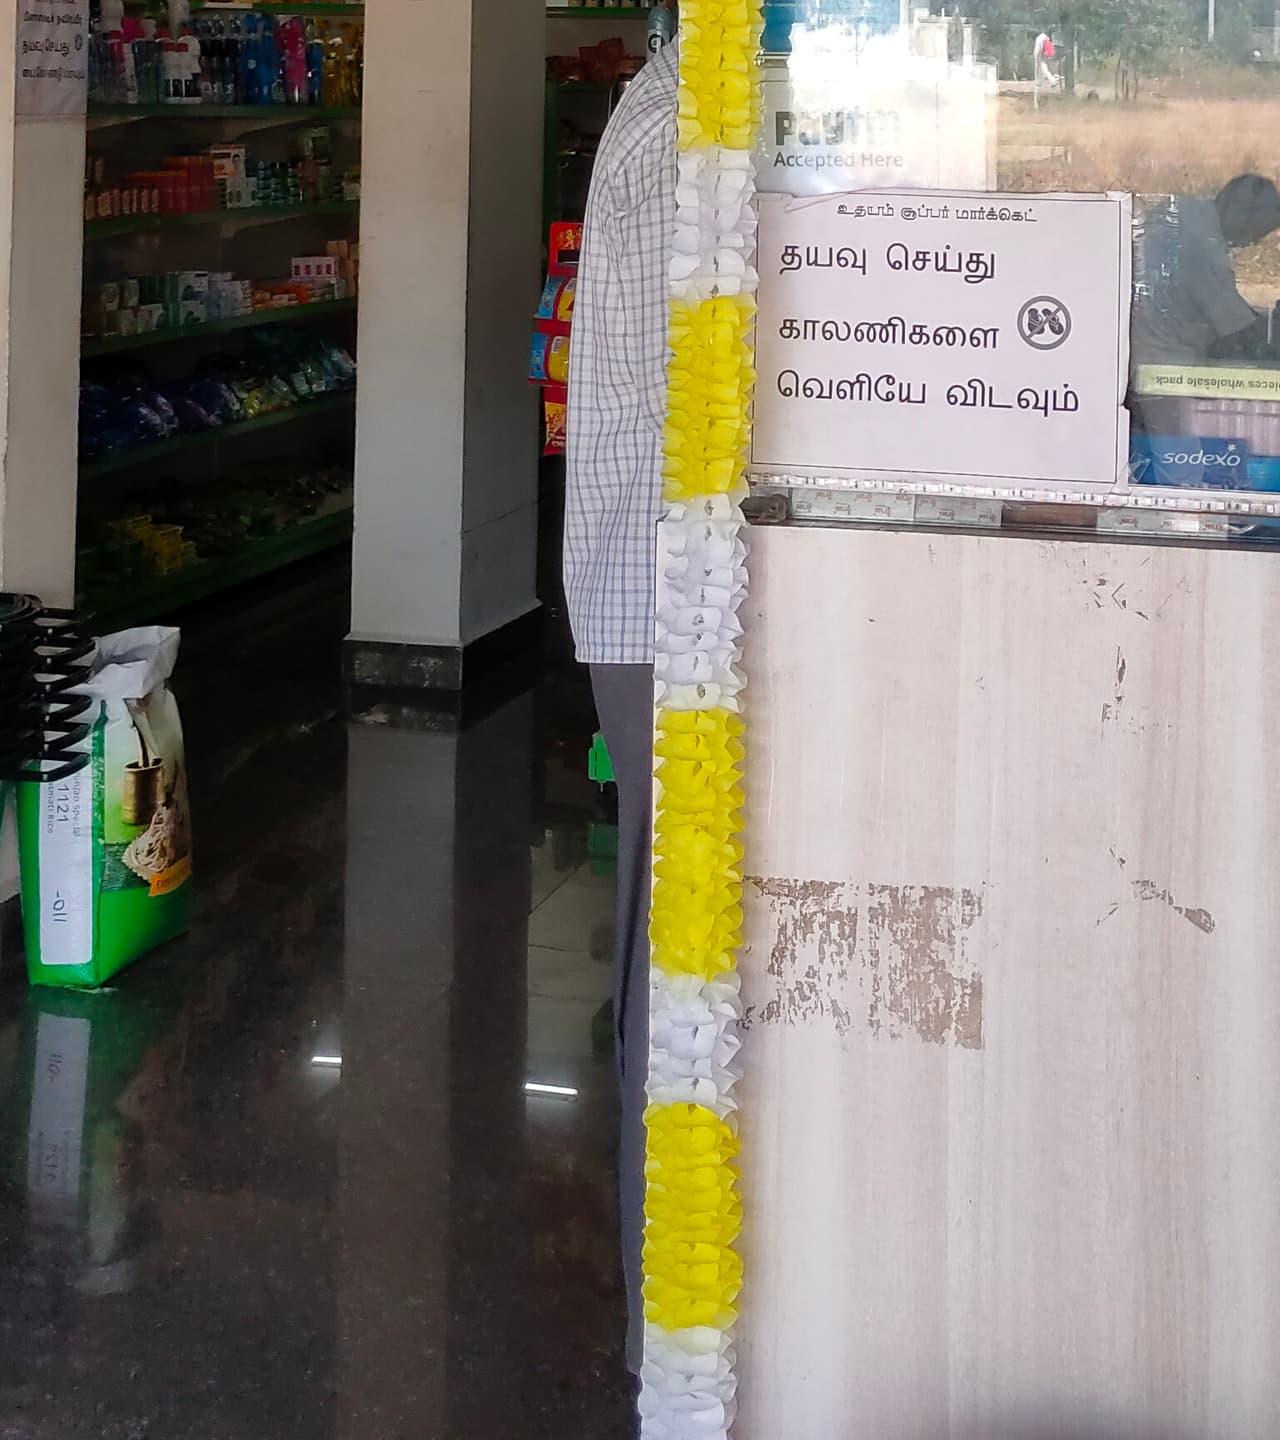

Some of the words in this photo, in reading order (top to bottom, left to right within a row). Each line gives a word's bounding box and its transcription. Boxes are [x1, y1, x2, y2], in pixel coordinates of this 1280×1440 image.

[773, 151, 855, 172] Accepted
[859, 152, 904, 169] Here
[836, 203, 895, 218] உதயம்
[900, 204, 951, 221] சூப்பர்
[955, 206, 1038, 223] மார்க்கெட்
[778, 242, 867, 276] தயவு
[885, 242, 996, 285] செய்து
[778, 315, 1000, 350] காலணிகளை
[1154, 374, 1184, 386] pack
[1186, 375, 1244, 392] wholesale
[776, 369, 927, 405] வெளியே
[946, 378, 1080, 418] விடவும்
[1161, 449, 1241, 467] sodexo
[56, 783, 70, 823] 1121
